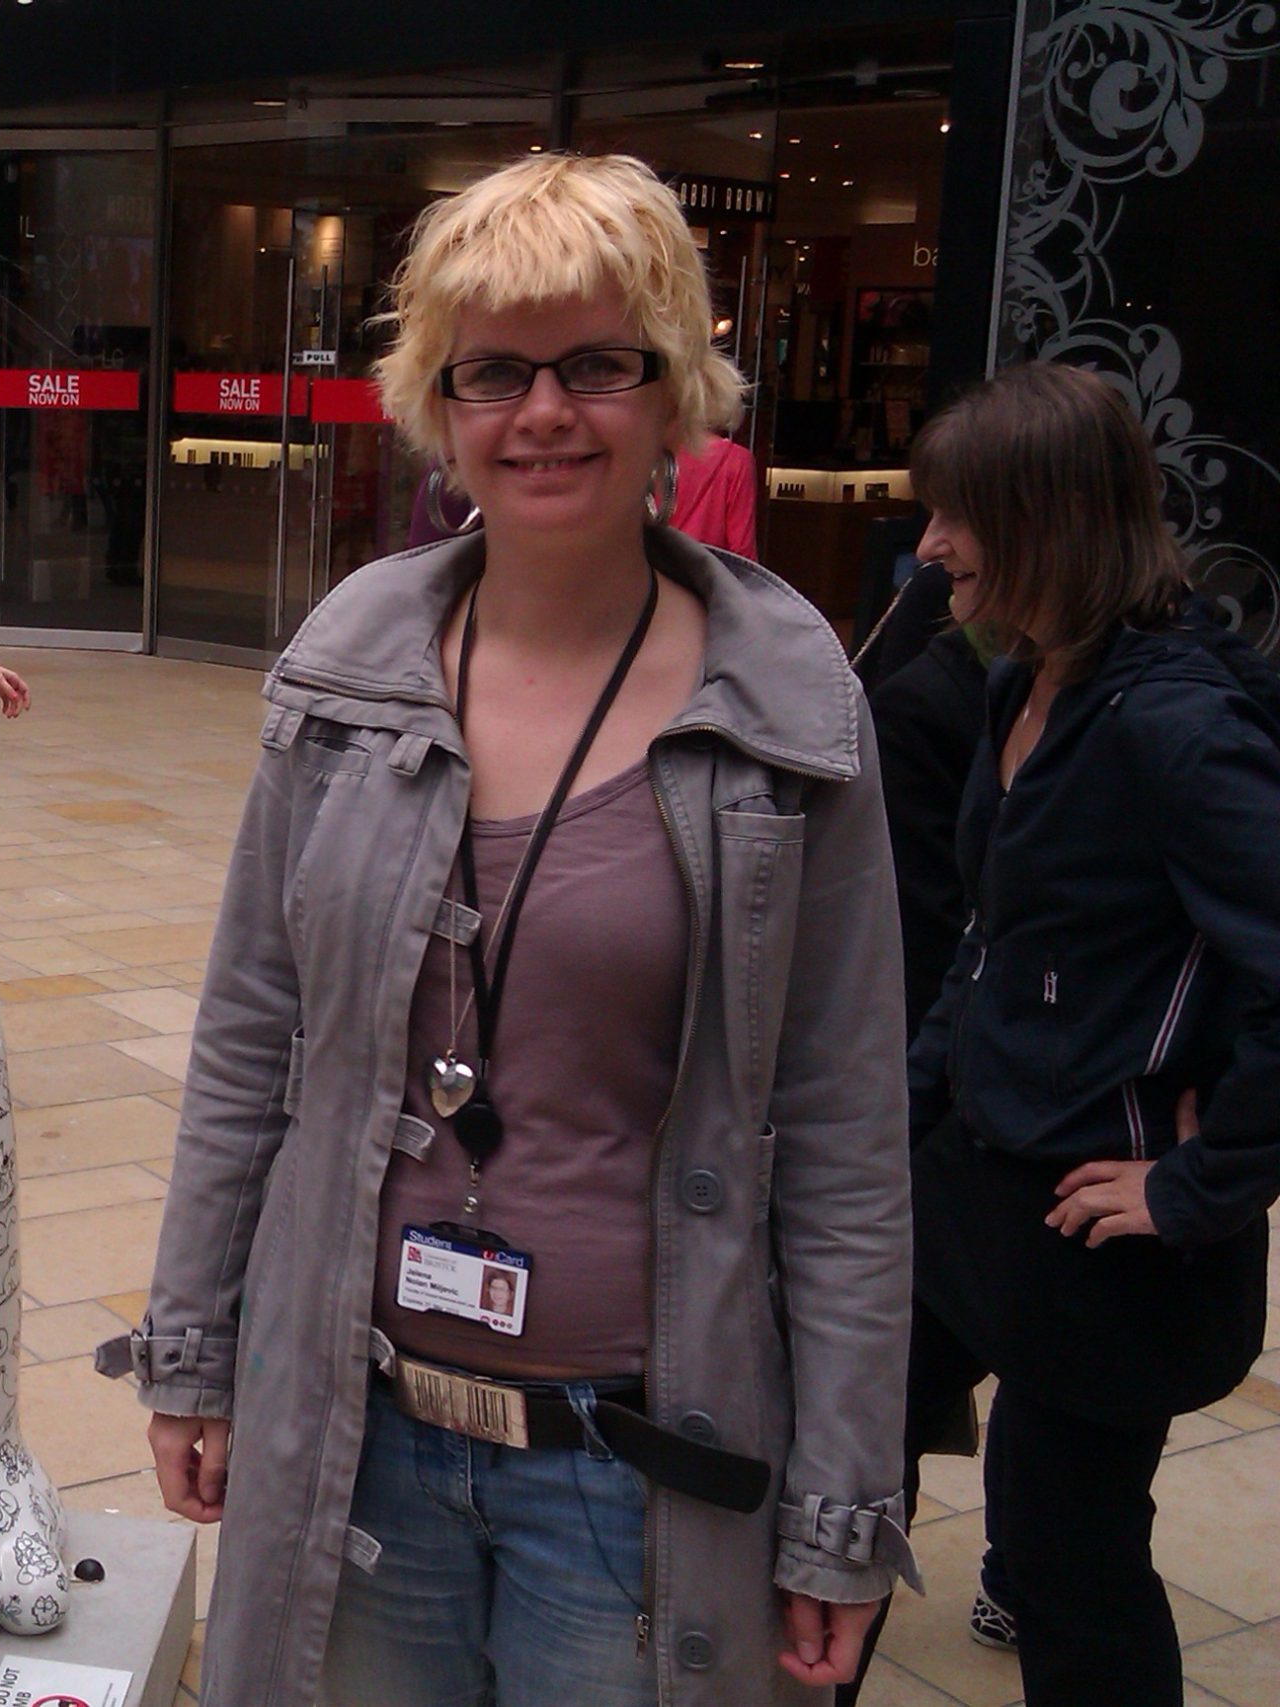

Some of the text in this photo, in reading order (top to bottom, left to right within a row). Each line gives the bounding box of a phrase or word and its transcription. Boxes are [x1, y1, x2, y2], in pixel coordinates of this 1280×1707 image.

[307, 353, 332, 362] PULL
[28, 374, 80, 394] SALE
[220, 378, 261, 398] SALE
[28, 393, 80, 406] NOW ON
[220, 398, 260, 411] NOW ON
[0, 1667, 21, 1689] NOT
